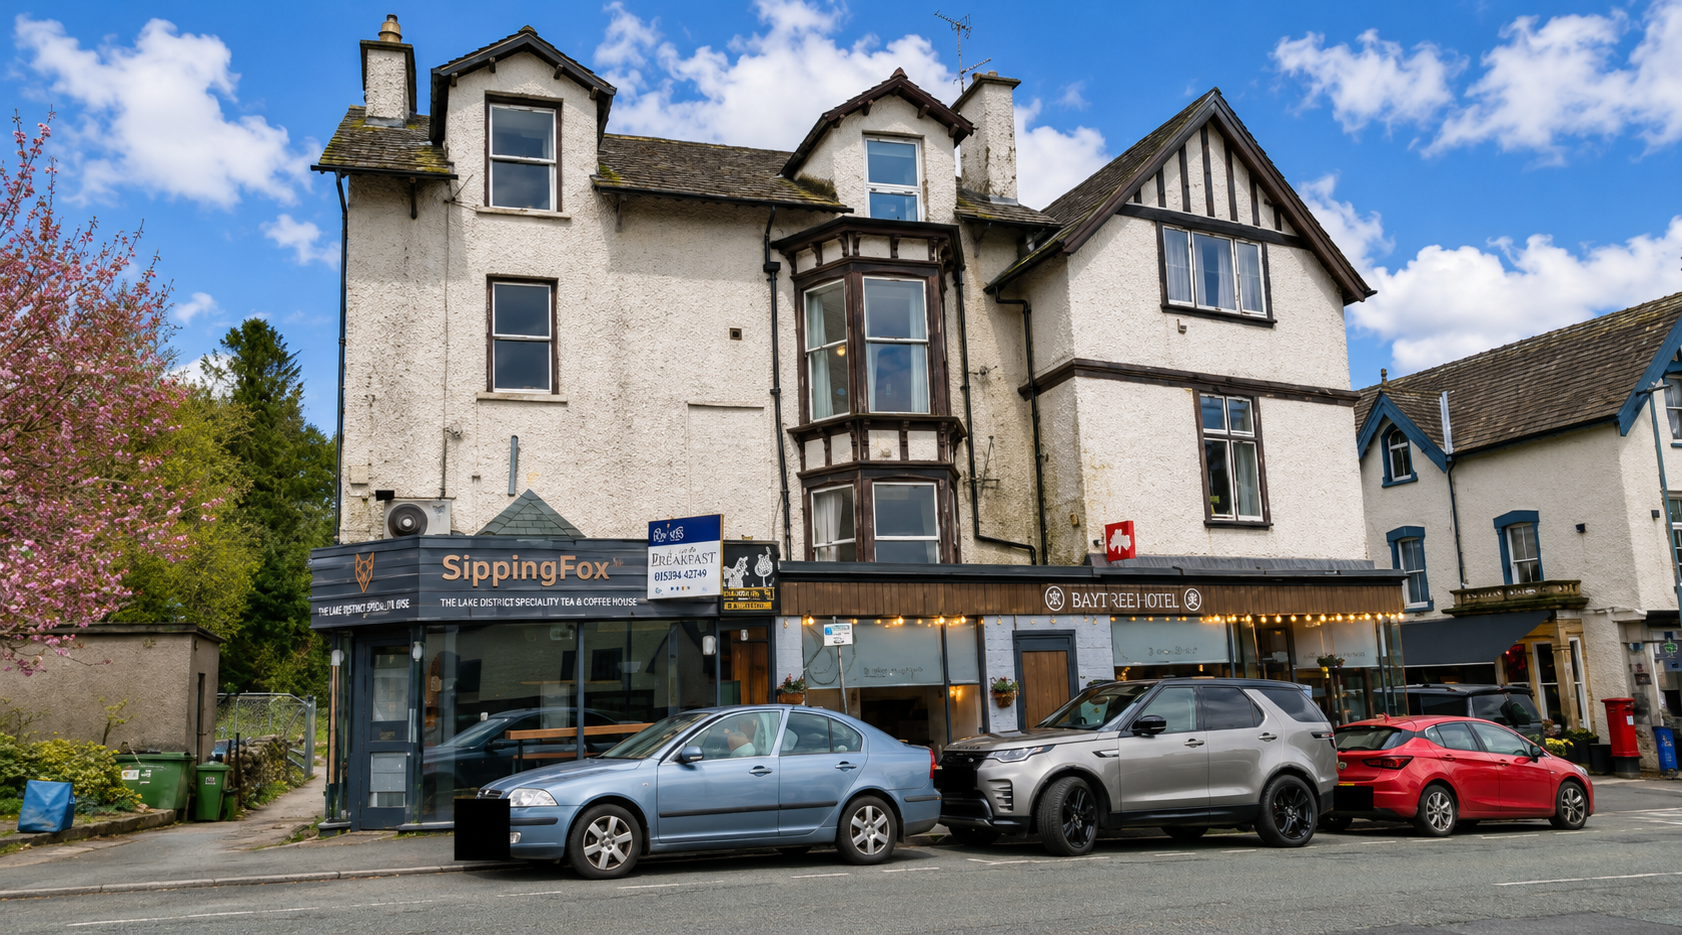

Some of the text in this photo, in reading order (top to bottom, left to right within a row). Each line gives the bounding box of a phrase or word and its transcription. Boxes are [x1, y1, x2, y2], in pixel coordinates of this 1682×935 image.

[442, 554, 610, 587] SippingFox
[440, 598, 457, 607] THE
[458, 598, 479, 607] LAKE
[480, 598, 515, 607] DISTRICT
[515, 597, 559, 607] SPECIALITY
[560, 597, 575, 607] TEA
